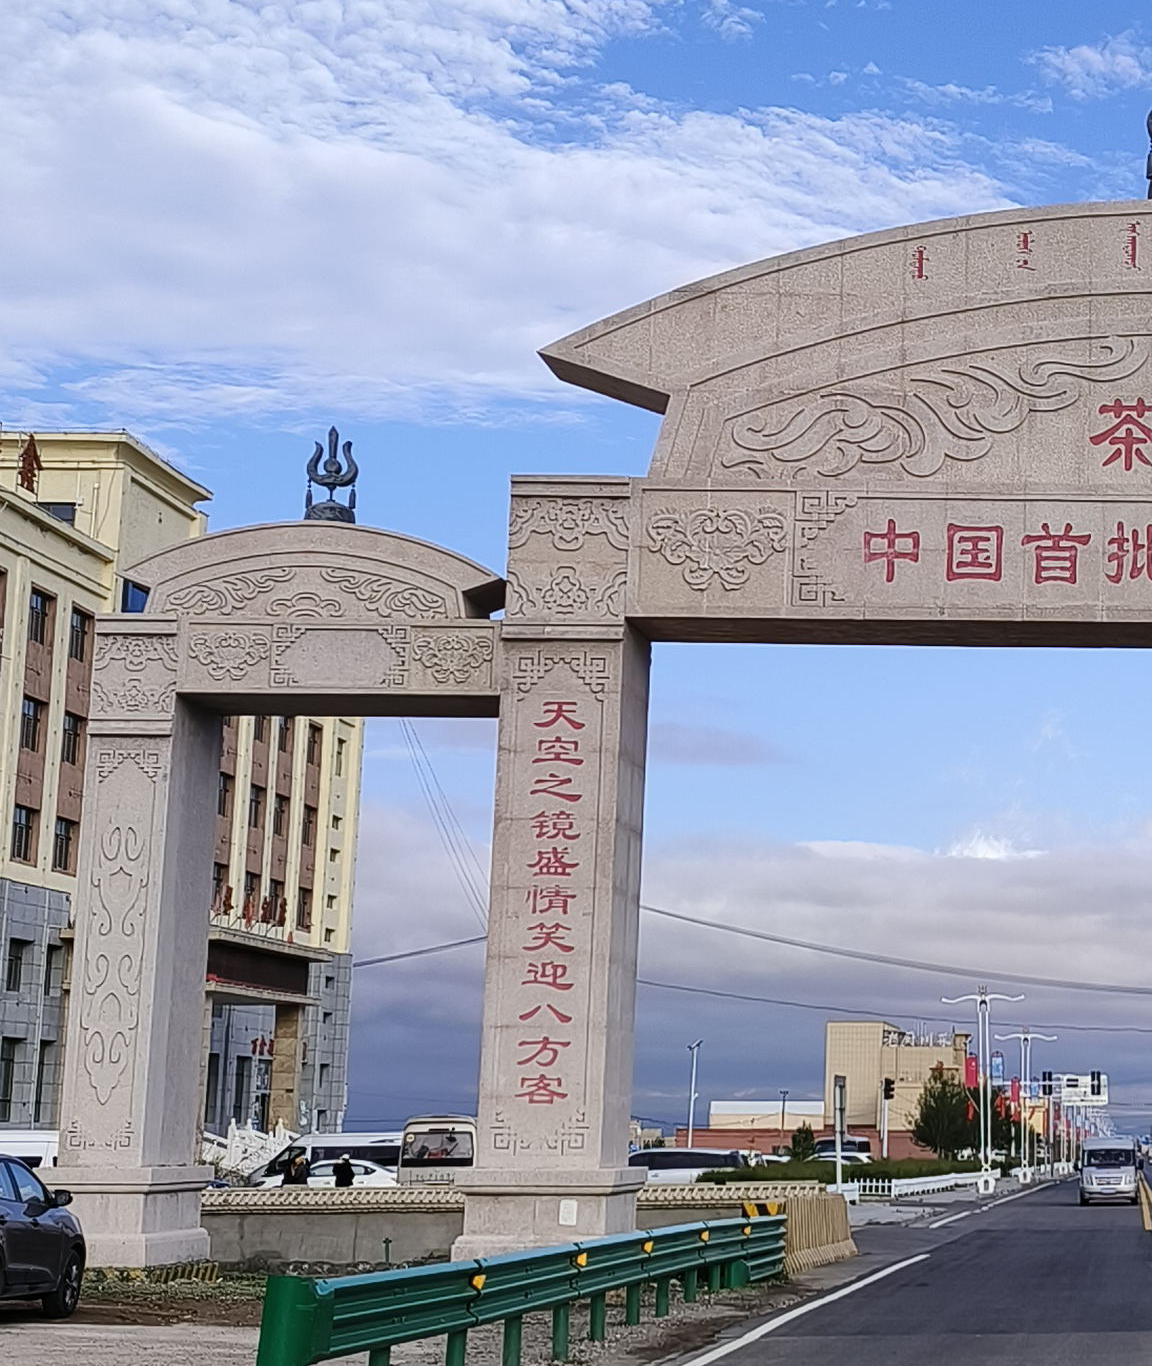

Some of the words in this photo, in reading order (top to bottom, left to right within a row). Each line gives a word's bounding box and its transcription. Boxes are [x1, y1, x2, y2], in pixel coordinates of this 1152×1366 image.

[514, 700, 586, 1106] 天空之镜盛情笑迎八方客
